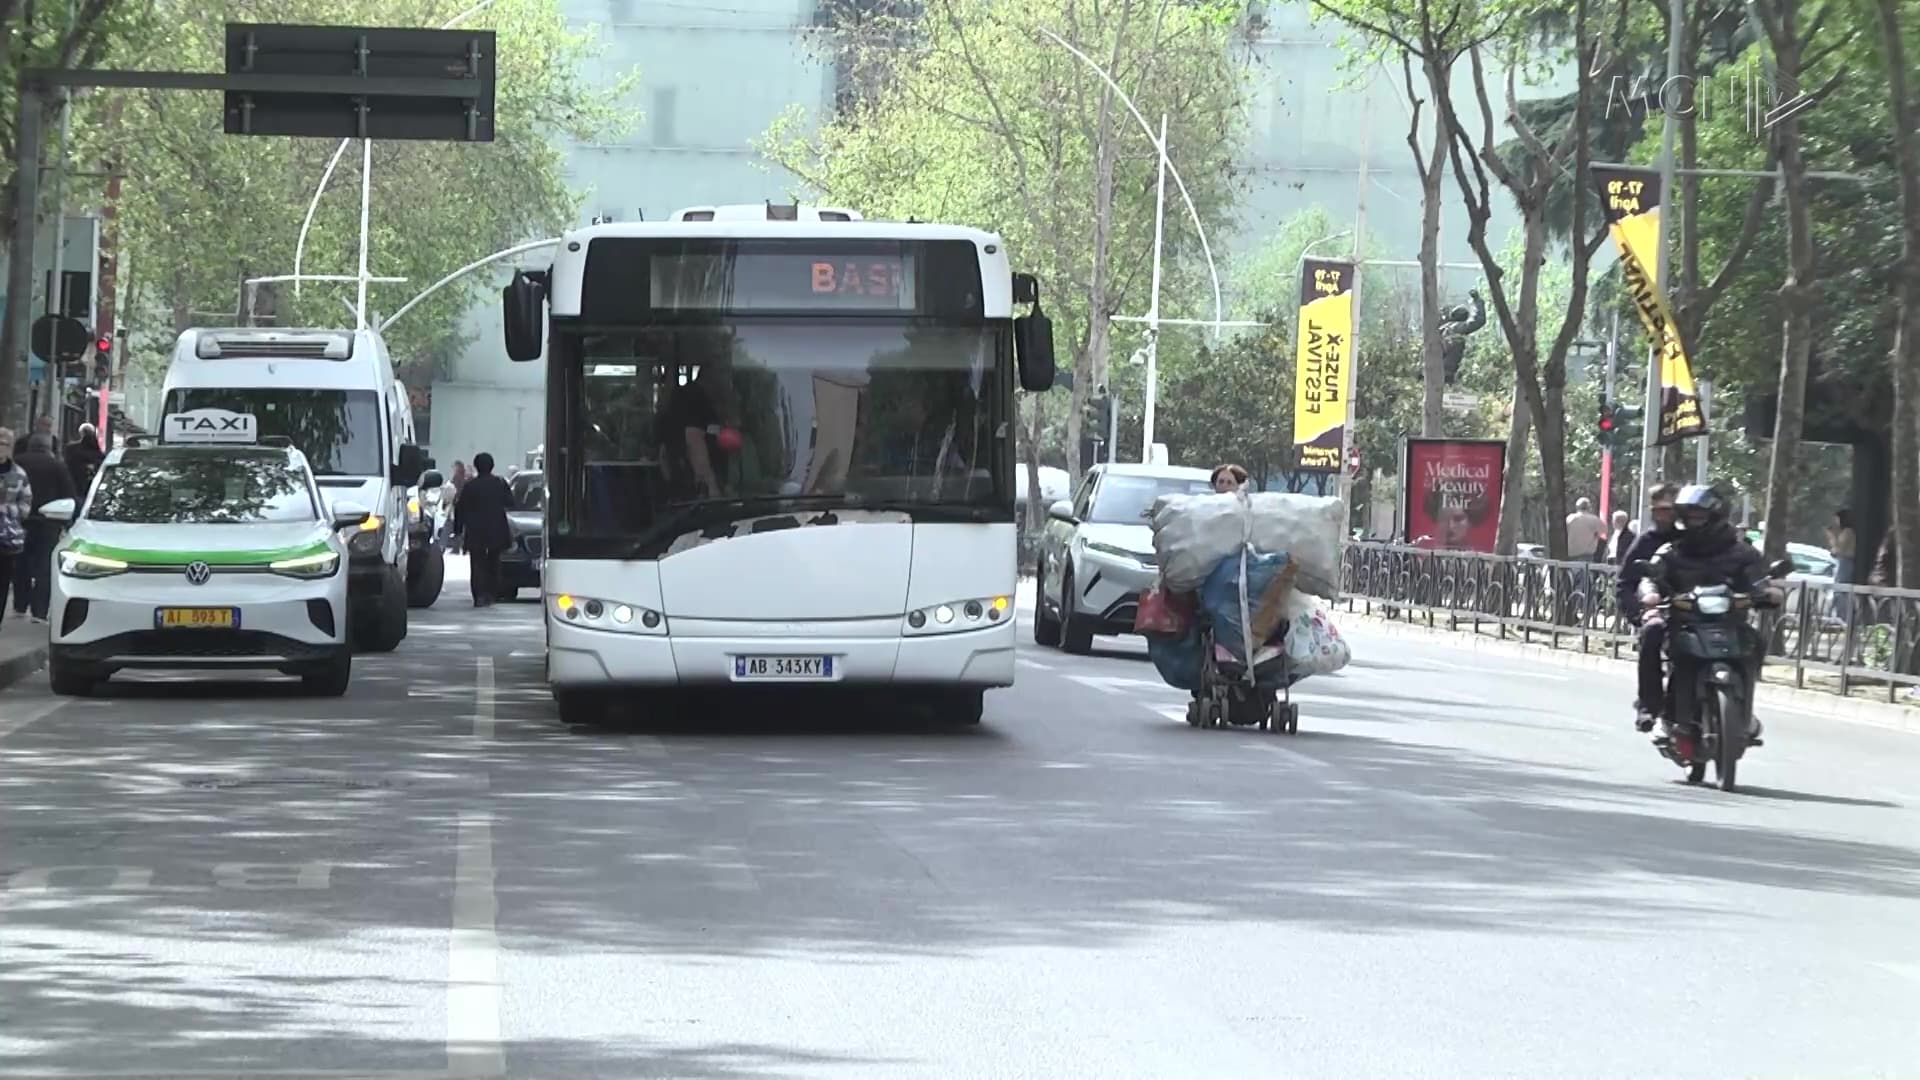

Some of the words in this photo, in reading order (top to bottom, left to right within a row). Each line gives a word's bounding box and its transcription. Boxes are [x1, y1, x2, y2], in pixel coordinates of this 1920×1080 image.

[173, 416, 249, 431] TAXI
[1424, 461, 1490, 479] Medical
[1431, 477, 1487, 498] Beauty
[1441, 493, 1473, 510] Fair
[749, 659, 768, 675] AB
